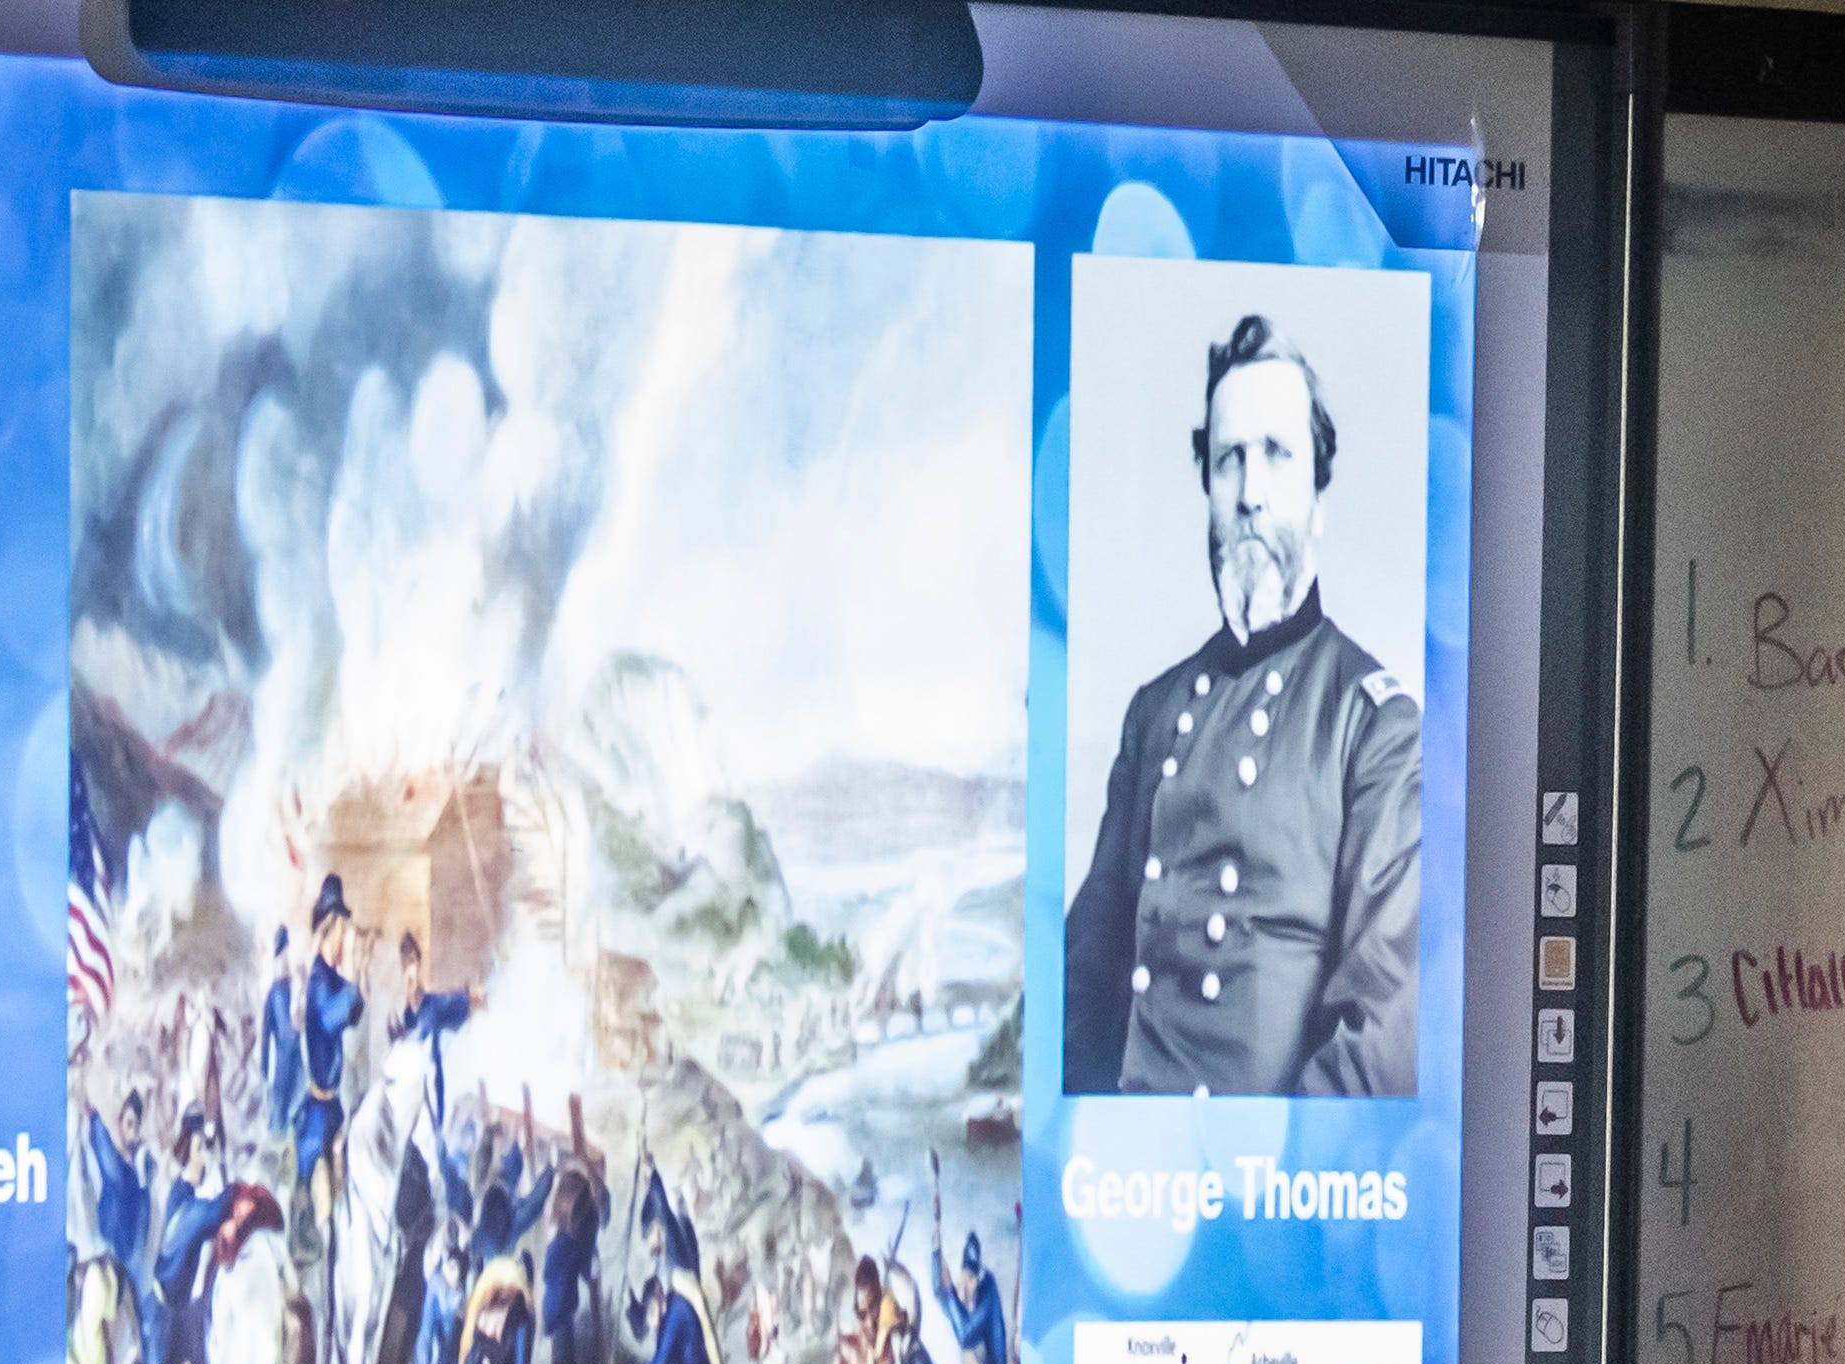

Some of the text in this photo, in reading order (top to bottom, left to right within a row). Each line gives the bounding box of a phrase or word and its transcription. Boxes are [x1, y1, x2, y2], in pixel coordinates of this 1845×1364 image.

[1406, 155, 1526, 190] HITACHI
[1669, 765, 1711, 852] 2
[1669, 954, 1716, 1047] 3
[1061, 1155, 1408, 1234] George Thomas
[1658, 1118, 1698, 1226] 4
[1128, 1336, 1176, 1356] Knoxville
